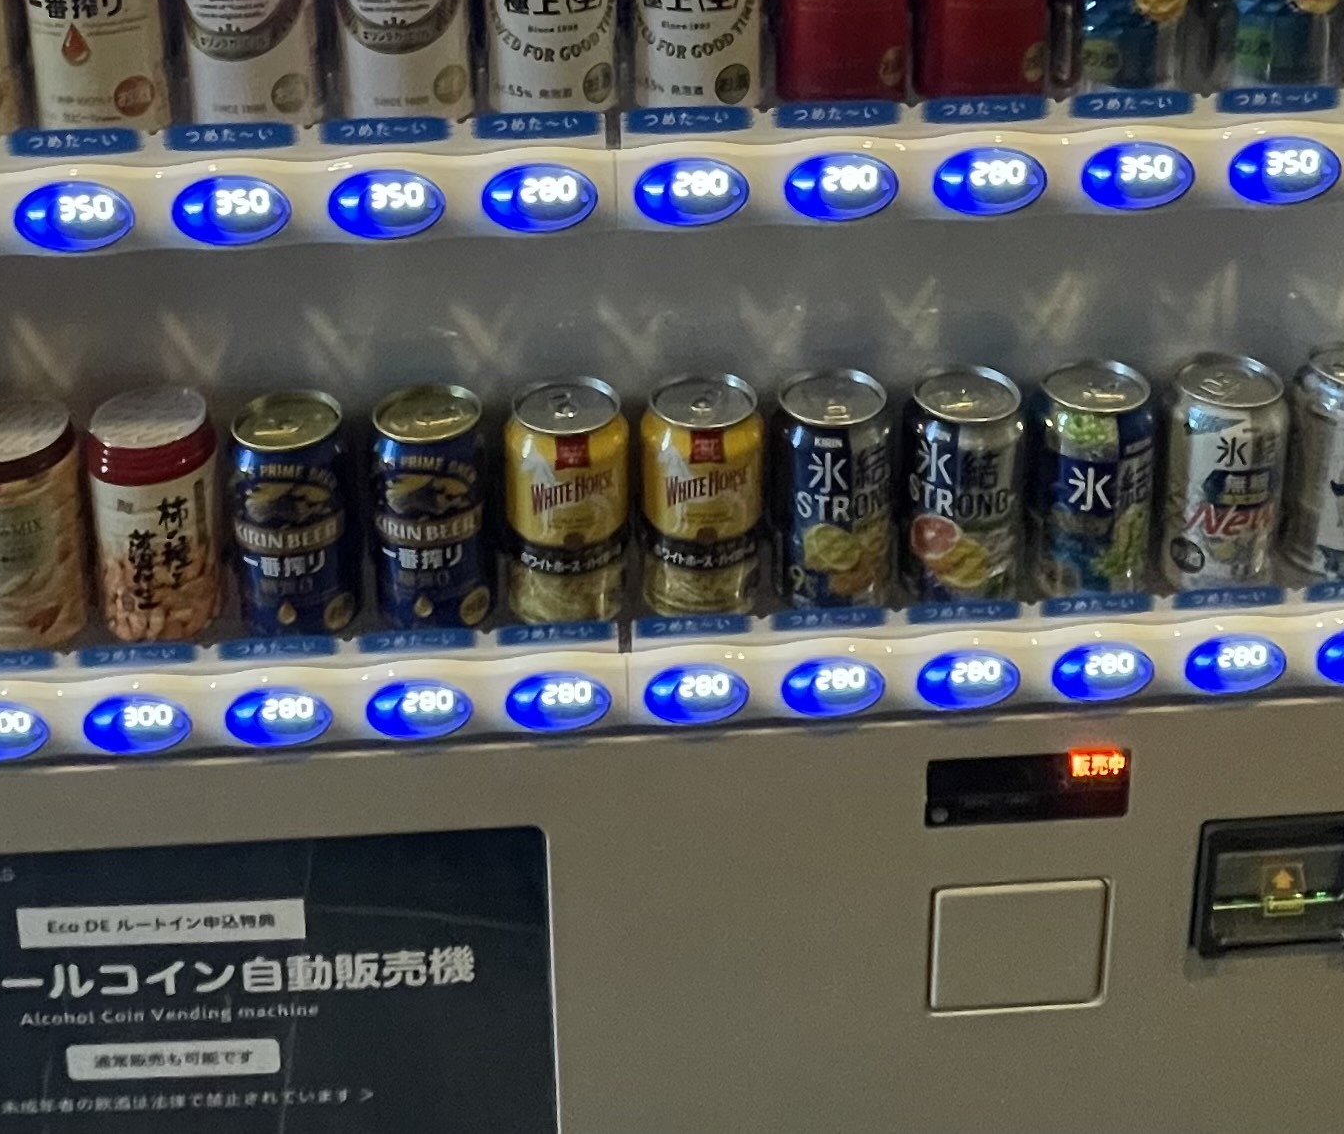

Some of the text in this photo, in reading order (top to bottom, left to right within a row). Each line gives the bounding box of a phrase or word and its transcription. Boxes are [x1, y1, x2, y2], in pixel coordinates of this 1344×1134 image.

[523, 32, 600, 63] FOR GOOD
[656, 32, 735, 60] FOR GOOD
[970, 160, 1026, 186] 280
[1121, 155, 1173, 181] 350
[1267, 149, 1319, 175] 350
[521, 176, 577, 203] 280
[673, 169, 728, 196] 280
[823, 165, 877, 191] 280
[60, 194, 114, 221] 350
[216, 189, 270, 215] 350
[371, 182, 424, 209] 350
[665, 476, 707, 507] WHITE
[235, 521, 284, 548] KIRIN
[1086, 652, 1134, 675] 280
[1218, 643, 1267, 667] 280
[816, 665, 865, 690] 280
[952, 658, 1001, 683] 280
[542, 681, 593, 705] 280
[679, 672, 729, 697] 280
[262, 696, 313, 720] 280
[403, 689, 453, 712] 280
[125, 704, 173, 727] 300
[1072, 753, 1125, 777] 販売中
[47, 920, 79, 934] Eco
[85, 919, 110, 933] DE
[20, 1003, 319, 1027] Alcohol Coin Vending machine
